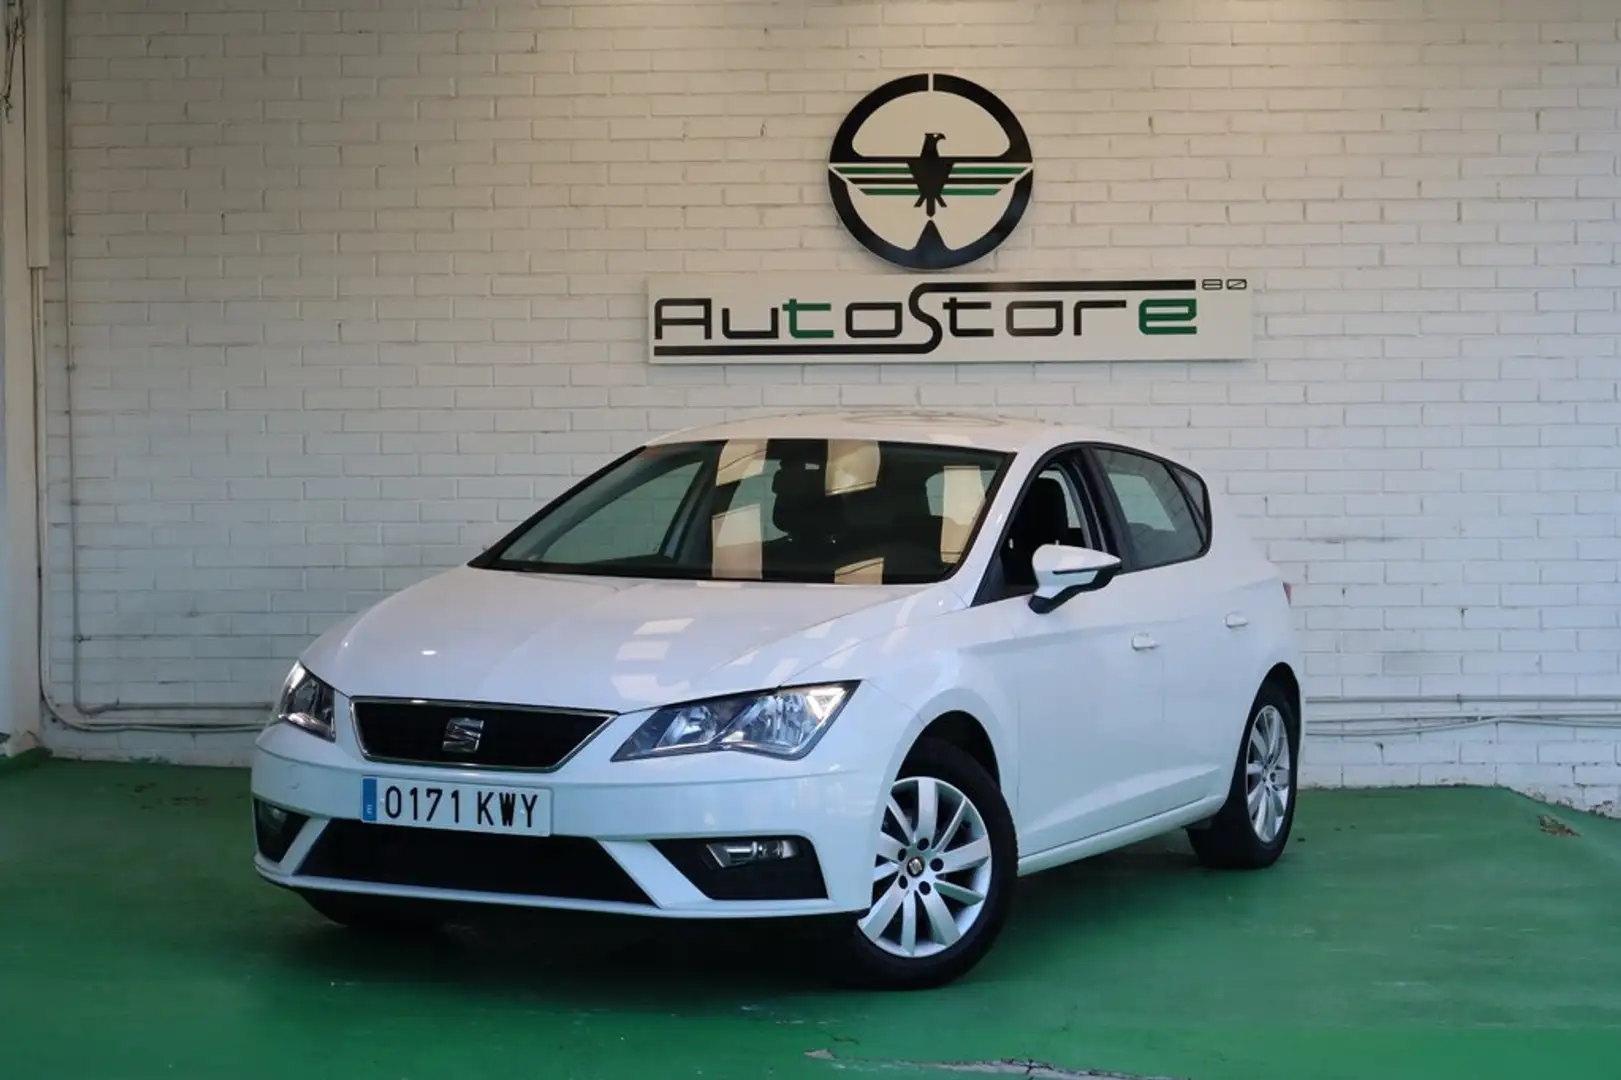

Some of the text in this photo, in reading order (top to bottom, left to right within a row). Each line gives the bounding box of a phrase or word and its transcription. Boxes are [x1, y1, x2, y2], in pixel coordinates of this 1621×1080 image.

[654, 280, 1197, 356] AutoStore
[385, 786, 538, 828] 0171 KWY
